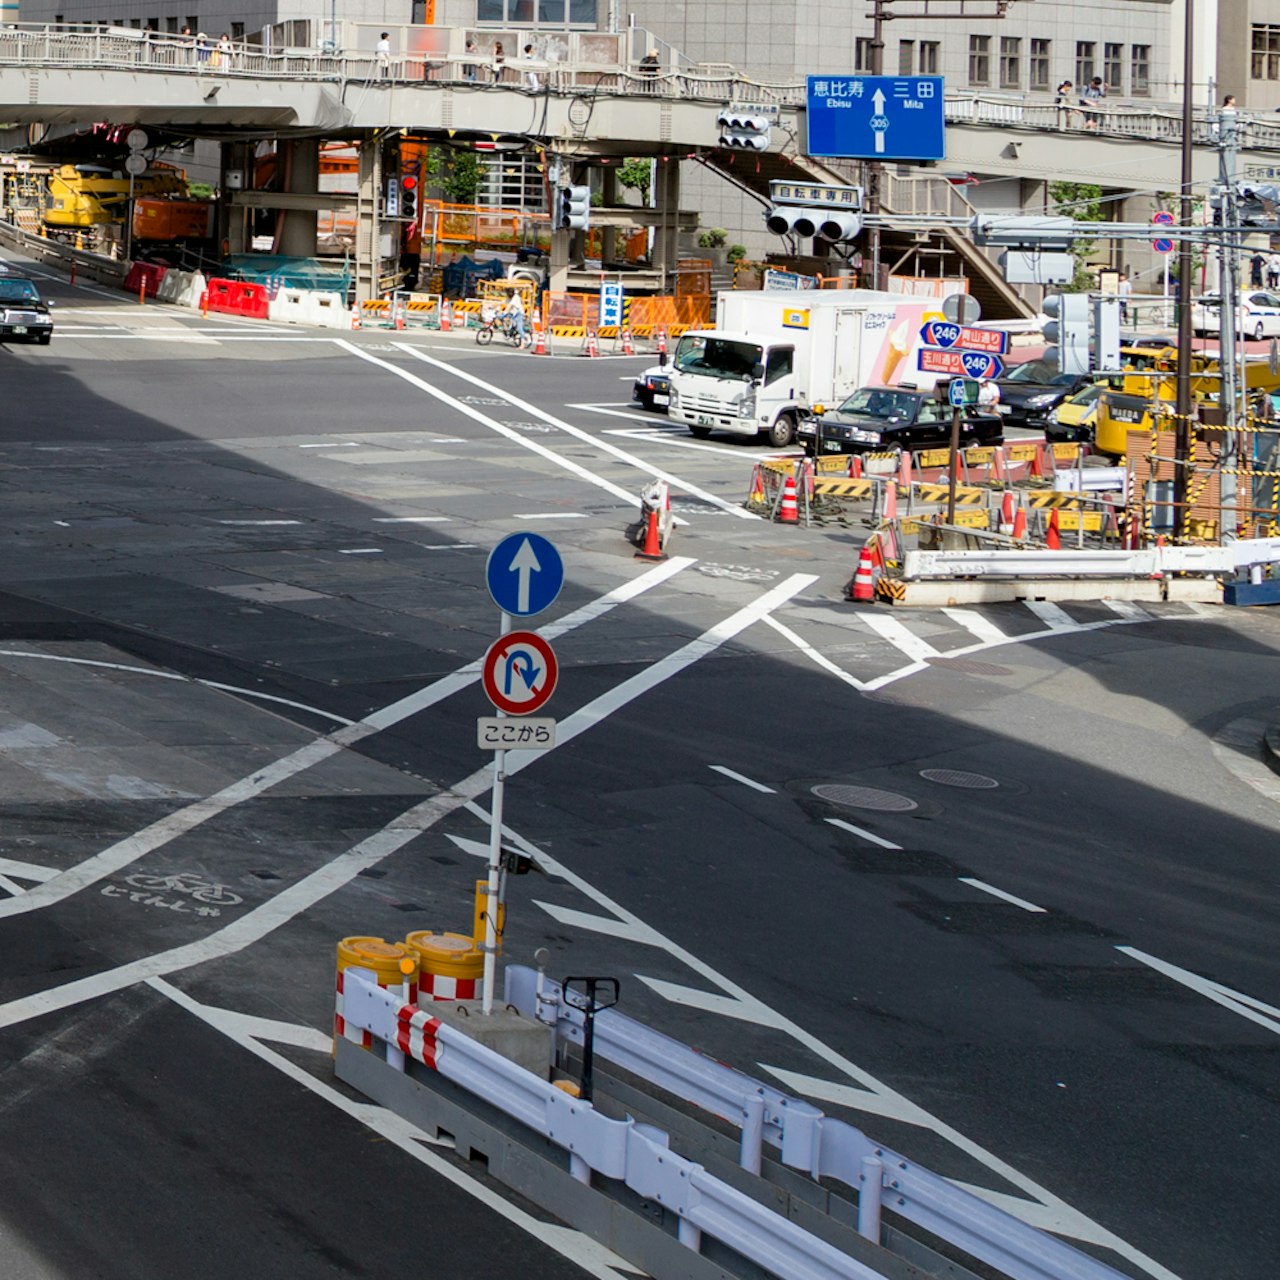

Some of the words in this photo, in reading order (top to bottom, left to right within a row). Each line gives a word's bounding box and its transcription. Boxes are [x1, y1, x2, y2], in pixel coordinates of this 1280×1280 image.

[813, 80, 865, 99] 恵比寿
[893, 81, 935, 100] 三田
[826, 99, 852, 109] Ebisu
[902, 98, 925, 111] Mita
[871, 118, 888, 128] 305
[780, 186, 853, 203] 自転車専用
[934, 325, 958, 341] 246
[961, 329, 1000, 345] 青山通り
[923, 351, 960, 366] 玉川通り
[965, 356, 988, 371] 246
[484, 724, 550, 743] ここから
